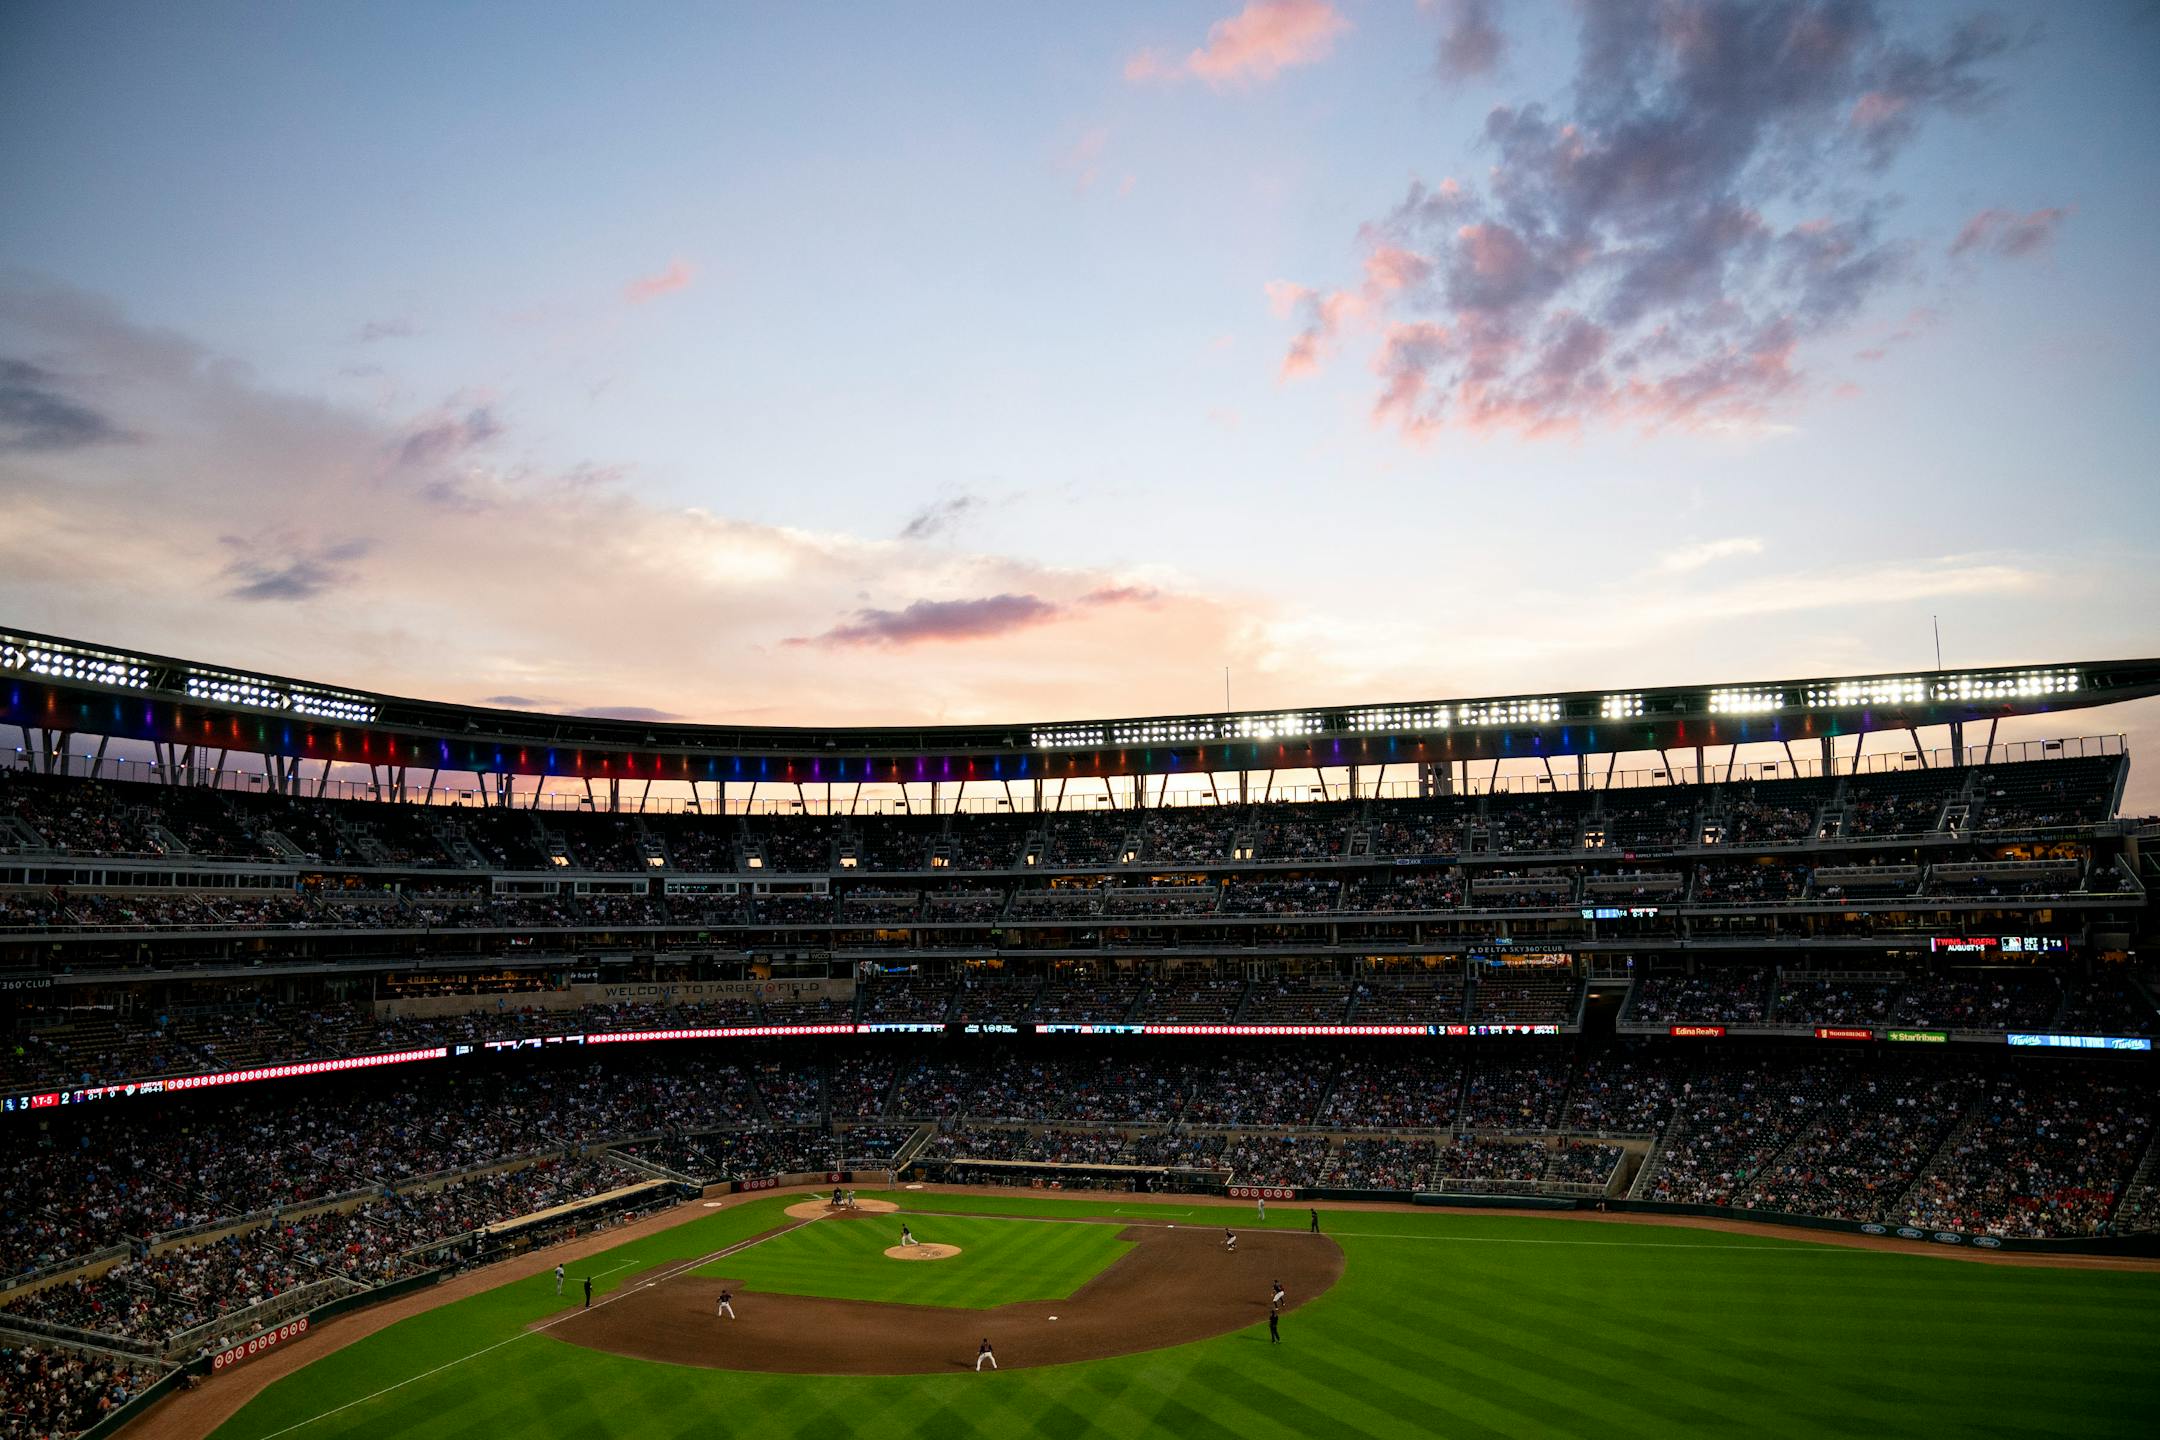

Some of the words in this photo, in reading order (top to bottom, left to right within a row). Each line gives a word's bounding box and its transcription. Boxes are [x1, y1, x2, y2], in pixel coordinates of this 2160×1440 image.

[1936, 938, 1961, 946] TWINS
[1968, 938, 1997, 946] TIGERS
[606, 985, 679, 996] WELCOME
[684, 984, 703, 993] TO
[709, 983, 763, 993] TARGET
[778, 982, 820, 992] FIELD
[1676, 1027, 1695, 1035] Edina
[1696, 1027, 1719, 1037] Realty
[2011, 1035, 2041, 1045] Twins
[2112, 1039, 2145, 1049] Twins
[20, 1097, 29, 1109] 3
[38, 1096, 53, 1105] T-5
[61, 1092, 70, 1104] 2
